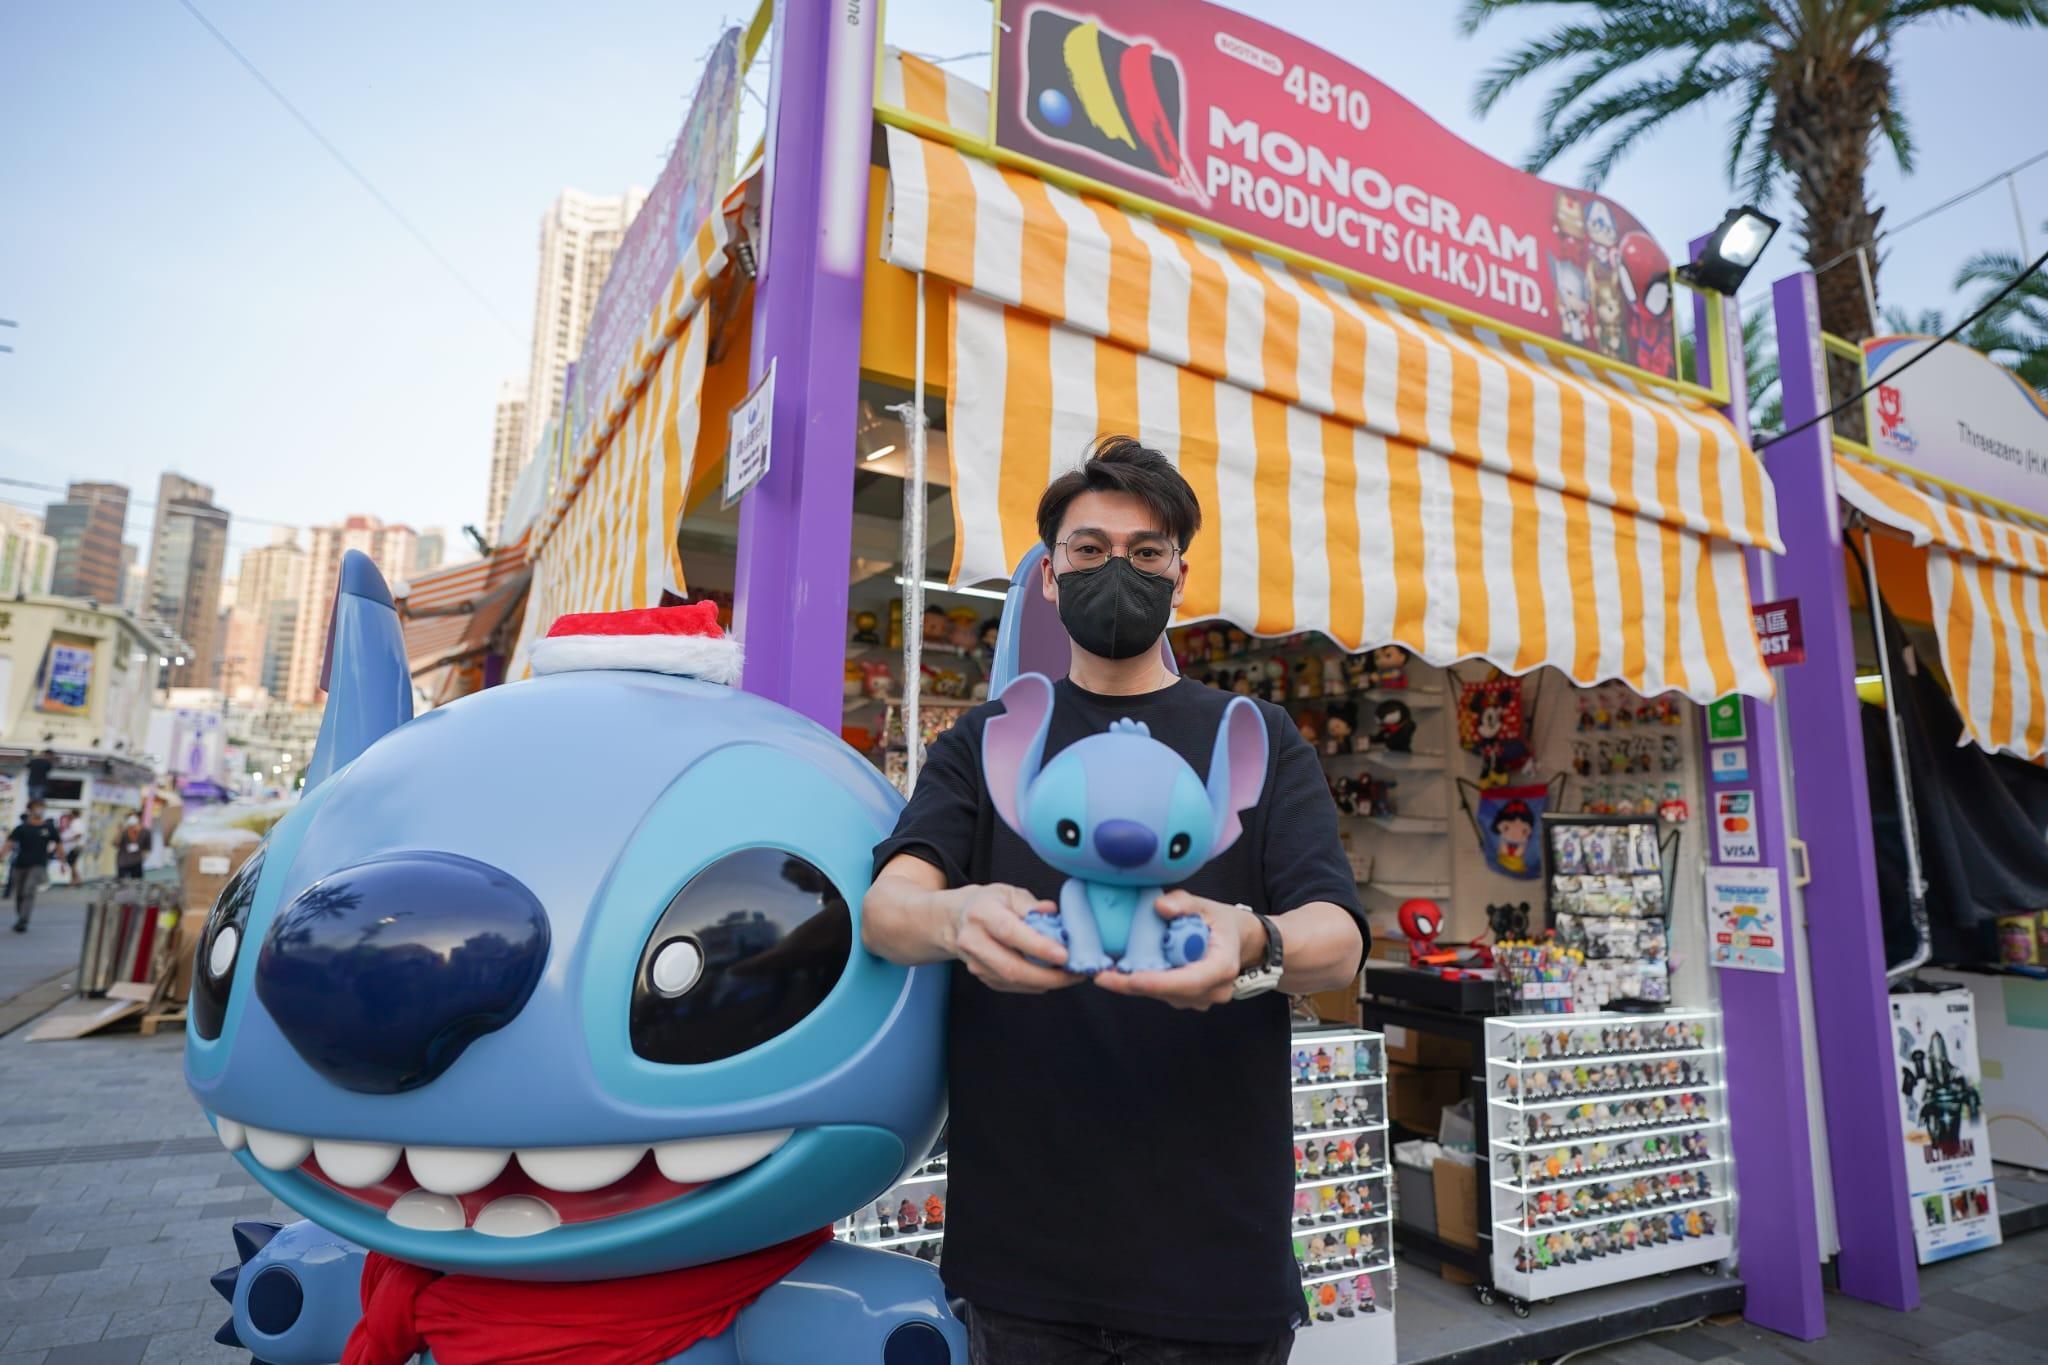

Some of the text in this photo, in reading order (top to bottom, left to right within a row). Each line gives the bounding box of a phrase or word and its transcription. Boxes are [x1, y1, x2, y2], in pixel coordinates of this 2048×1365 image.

[1220, 37, 1260, 62] BOOTH
[1283, 64, 1371, 131] 4B10
[1208, 105, 1538, 272] MONOGRAM
[1206, 154, 1400, 262] PRODUCTS
[1489, 262, 1550, 318] LTD.
[1957, 420, 2023, 467] Threezero
[1723, 845, 1756, 858] VISA
